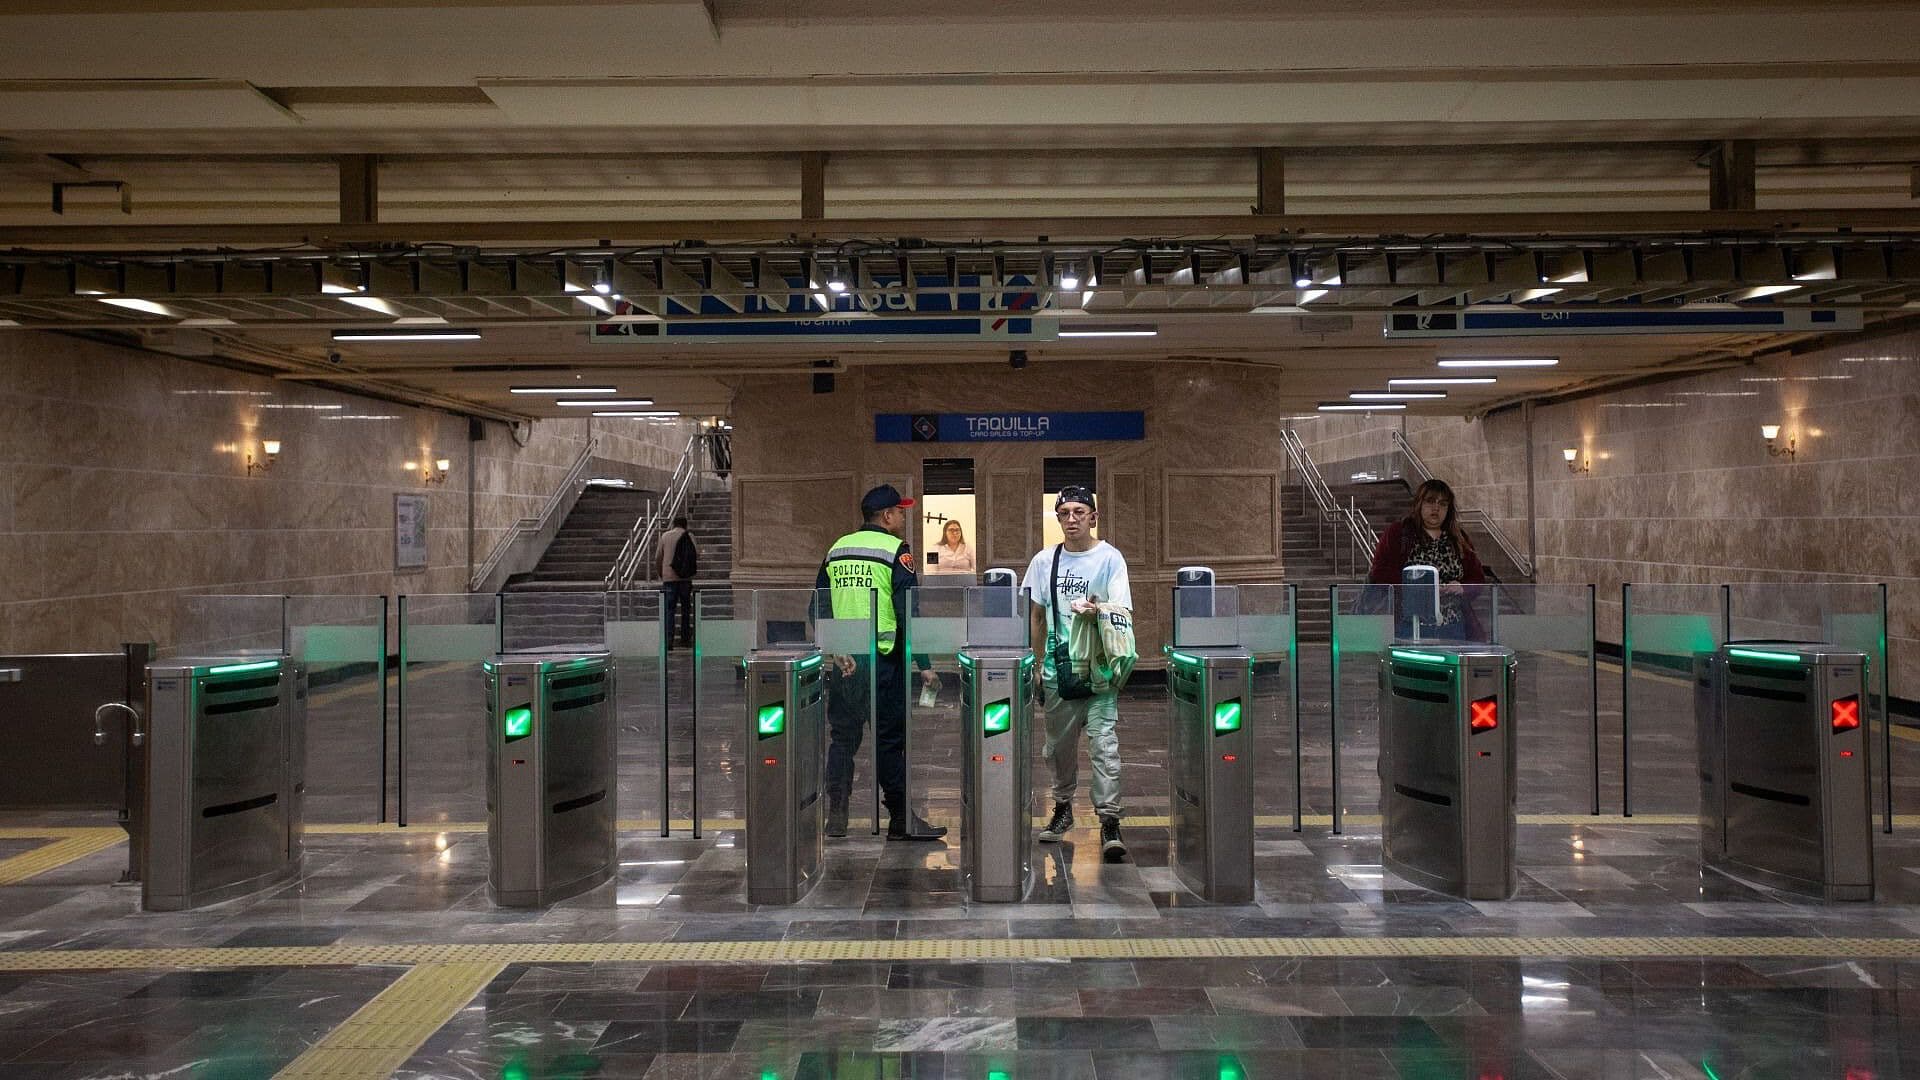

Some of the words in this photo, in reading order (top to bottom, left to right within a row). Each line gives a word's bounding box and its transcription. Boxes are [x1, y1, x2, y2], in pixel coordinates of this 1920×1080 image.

[966, 416, 1049, 431] TAQUILLA
[970, 430, 989, 438] CARD
[834, 576, 873, 589] METRO
